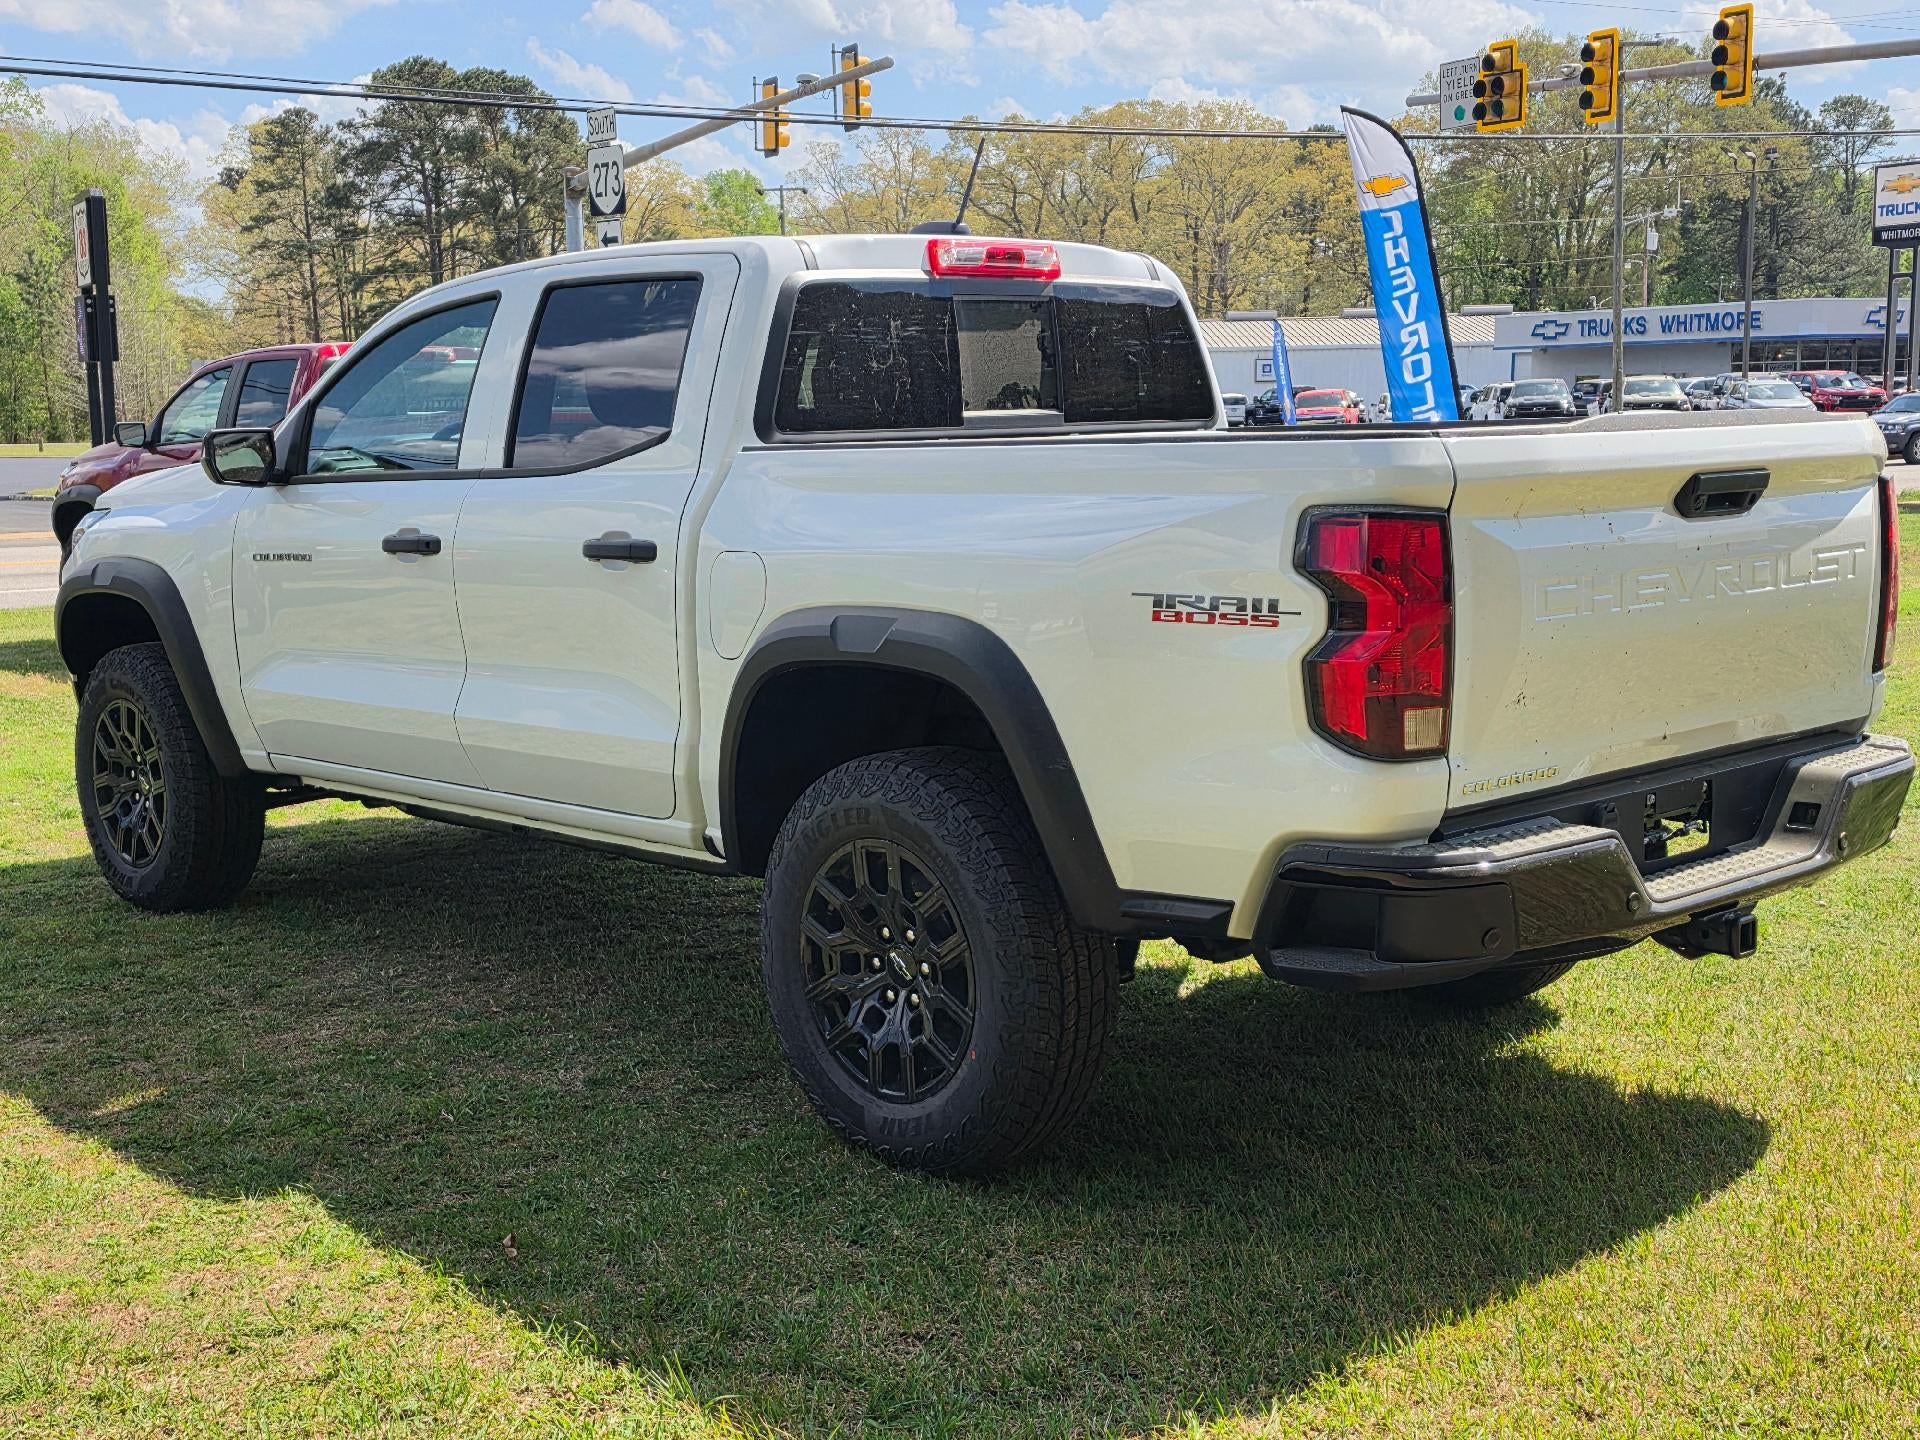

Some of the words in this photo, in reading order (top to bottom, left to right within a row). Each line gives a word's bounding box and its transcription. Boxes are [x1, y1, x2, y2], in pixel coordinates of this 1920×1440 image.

[1442, 65, 1459, 79] LEFT
[1460, 62, 1478, 75] TURN
[1445, 76, 1475, 91] YIELD
[1443, 93, 1453, 103] ON
[1455, 89, 1474, 101] GREE
[588, 115, 615, 136] SOUTH
[593, 160, 621, 198] 273
[1577, 315, 1648, 337] TRUKS
[1534, 541, 1867, 622] CHEVROLET
[1131, 592, 1302, 615] TRAIL
[1151, 609, 1280, 628] BOSS
[1462, 764, 1560, 795] COLORADO
